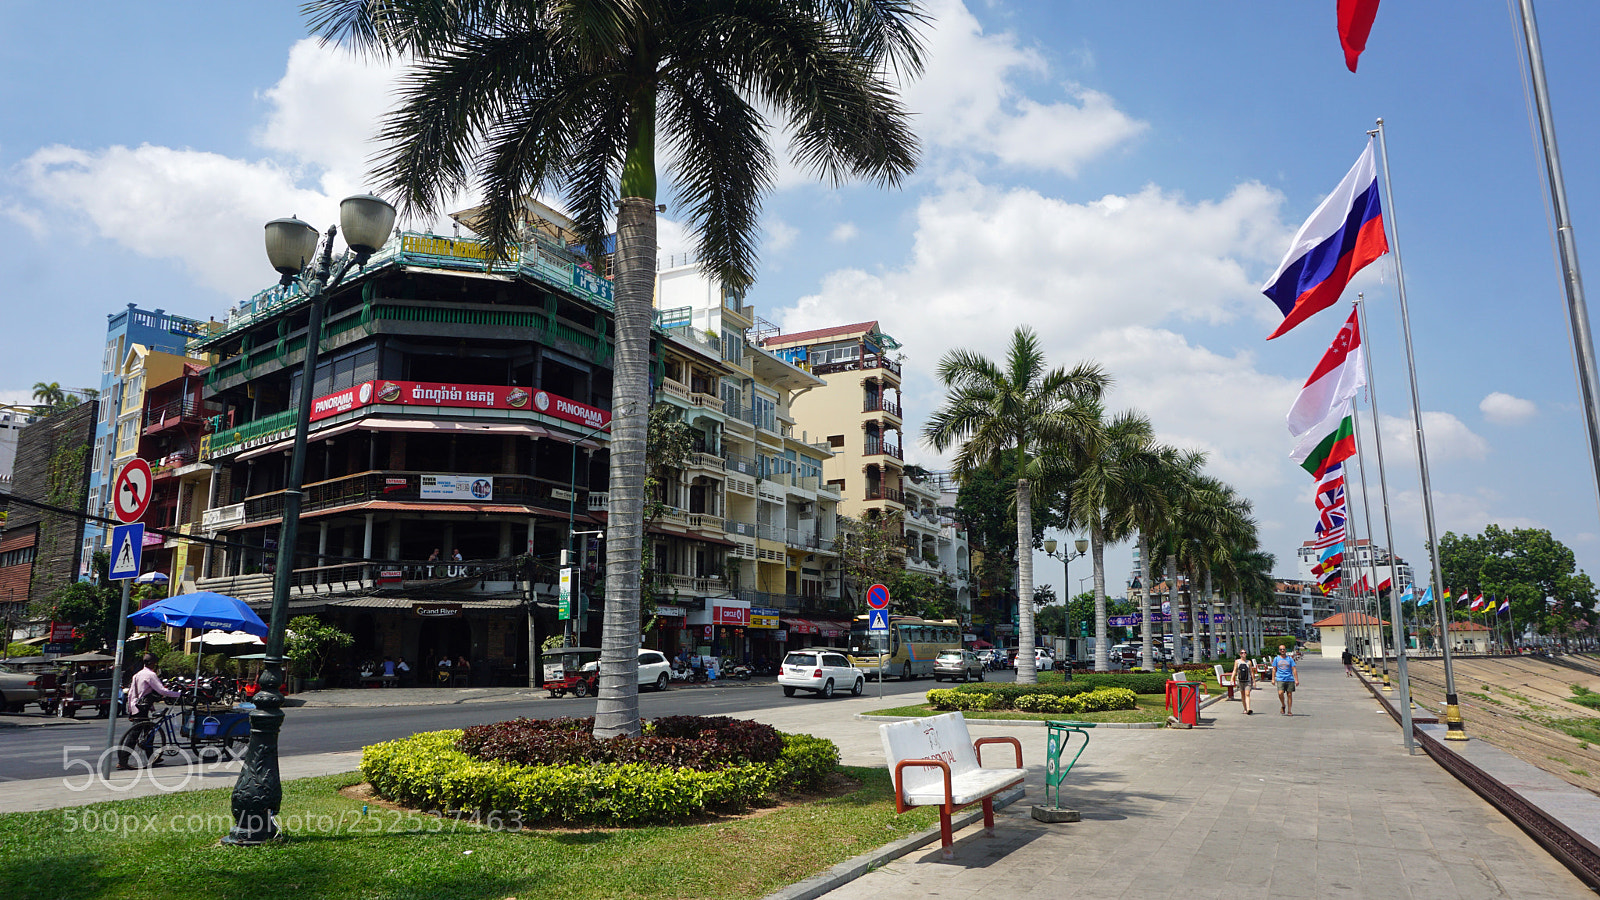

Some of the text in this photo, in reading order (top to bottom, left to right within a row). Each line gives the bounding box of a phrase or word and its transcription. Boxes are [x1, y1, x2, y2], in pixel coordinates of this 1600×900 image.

[403, 236, 451, 256] PANORAMA
[315, 392, 354, 413] PANORAMA
[557, 400, 603, 424] PANORAMA
[416, 606, 458, 616] Grand River
[203, 620, 232, 629] PEPSI
